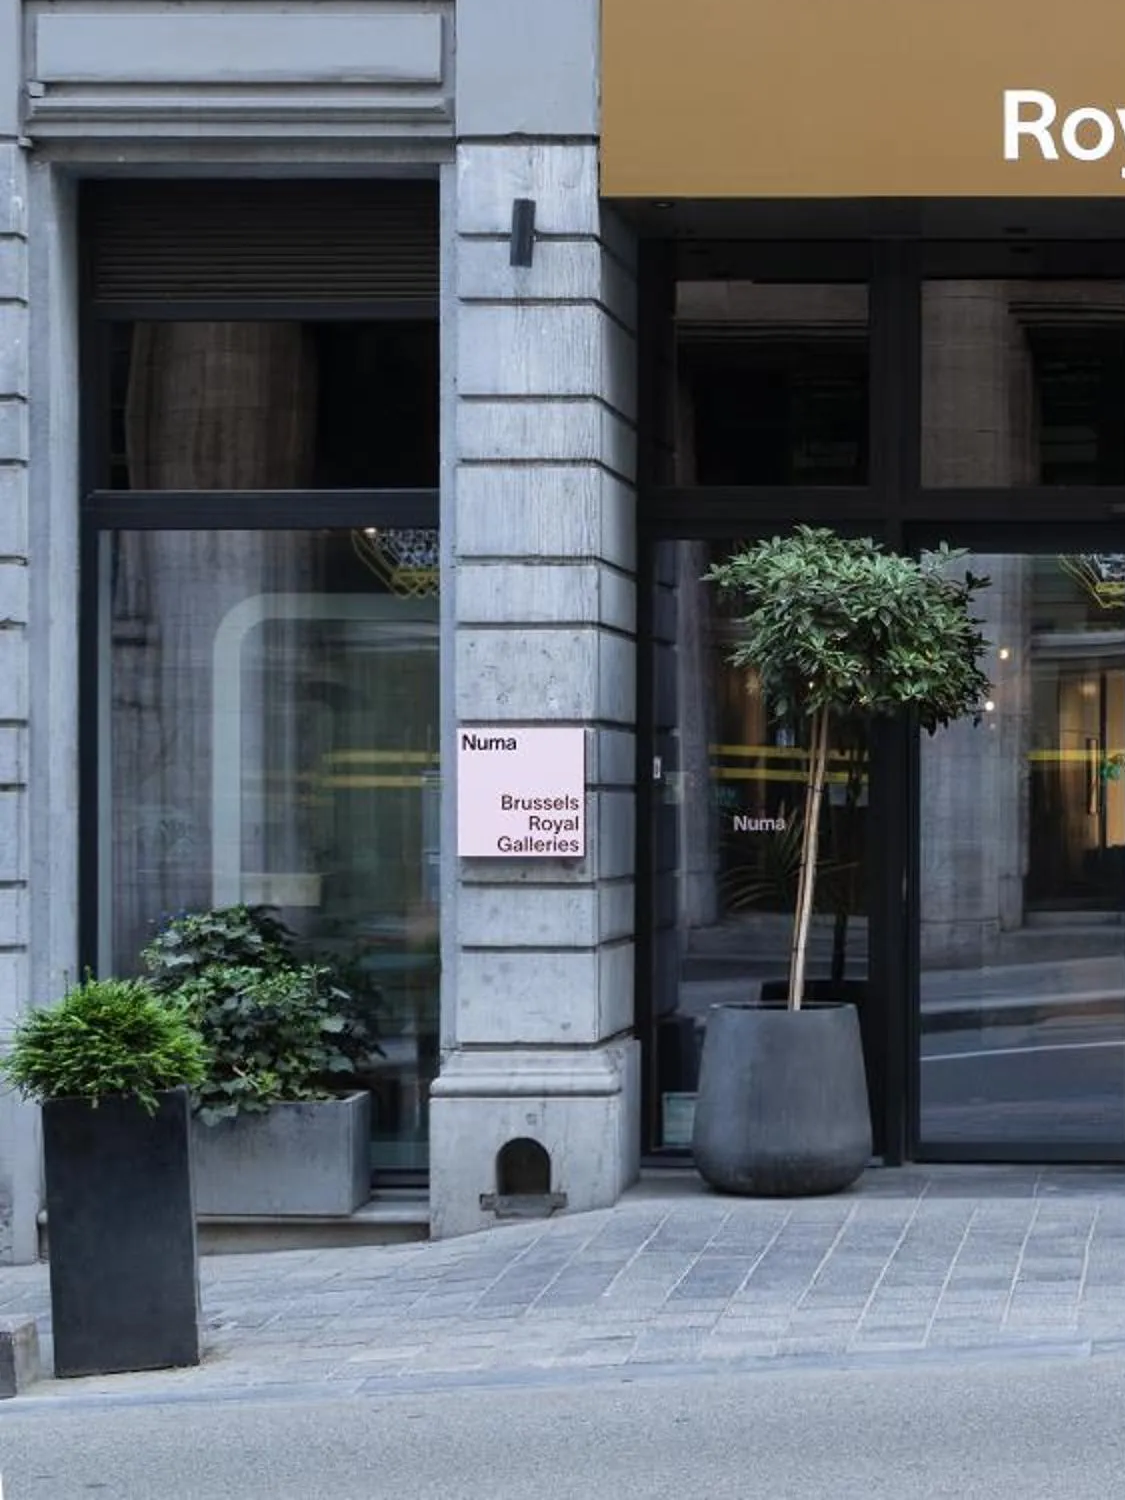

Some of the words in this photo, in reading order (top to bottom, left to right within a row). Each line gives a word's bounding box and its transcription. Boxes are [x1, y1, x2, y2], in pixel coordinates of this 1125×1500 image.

[462, 733, 517, 751] Numa
[501, 794, 580, 811] Brussels
[528, 815, 580, 835] Royal
[733, 815, 786, 832] Numa
[497, 836, 580, 853] Galleries
